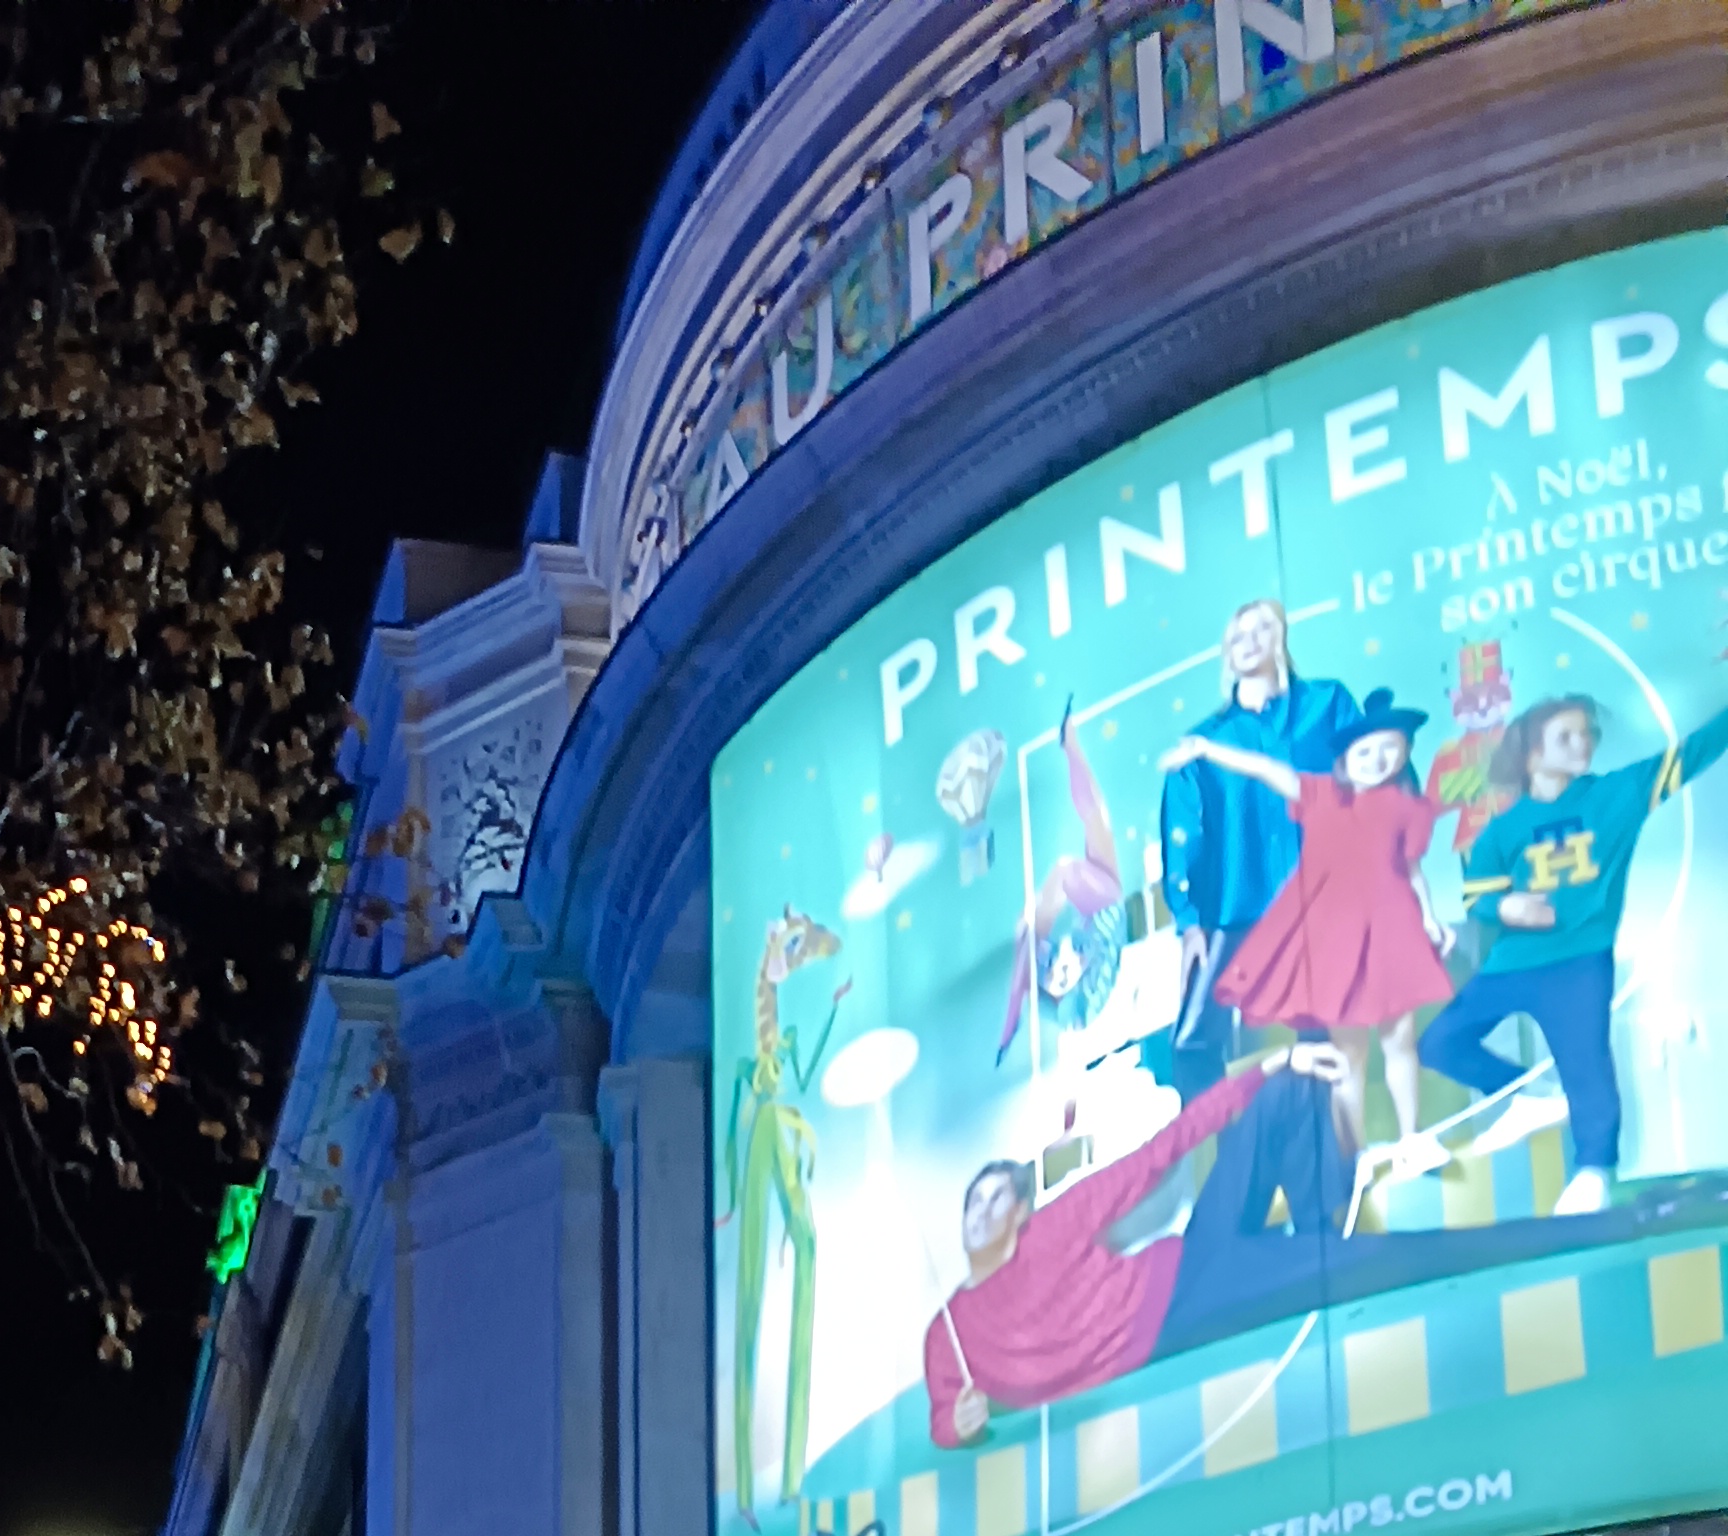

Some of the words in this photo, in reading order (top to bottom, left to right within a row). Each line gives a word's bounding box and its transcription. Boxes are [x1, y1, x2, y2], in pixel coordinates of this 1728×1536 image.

[704, 292, 834, 525] AU
[1352, 569, 1395, 614] le
[1412, 484, 1703, 593] Printemps
[1440, 575, 1536, 633] son
[1552, 529, 1728, 599] cirque
